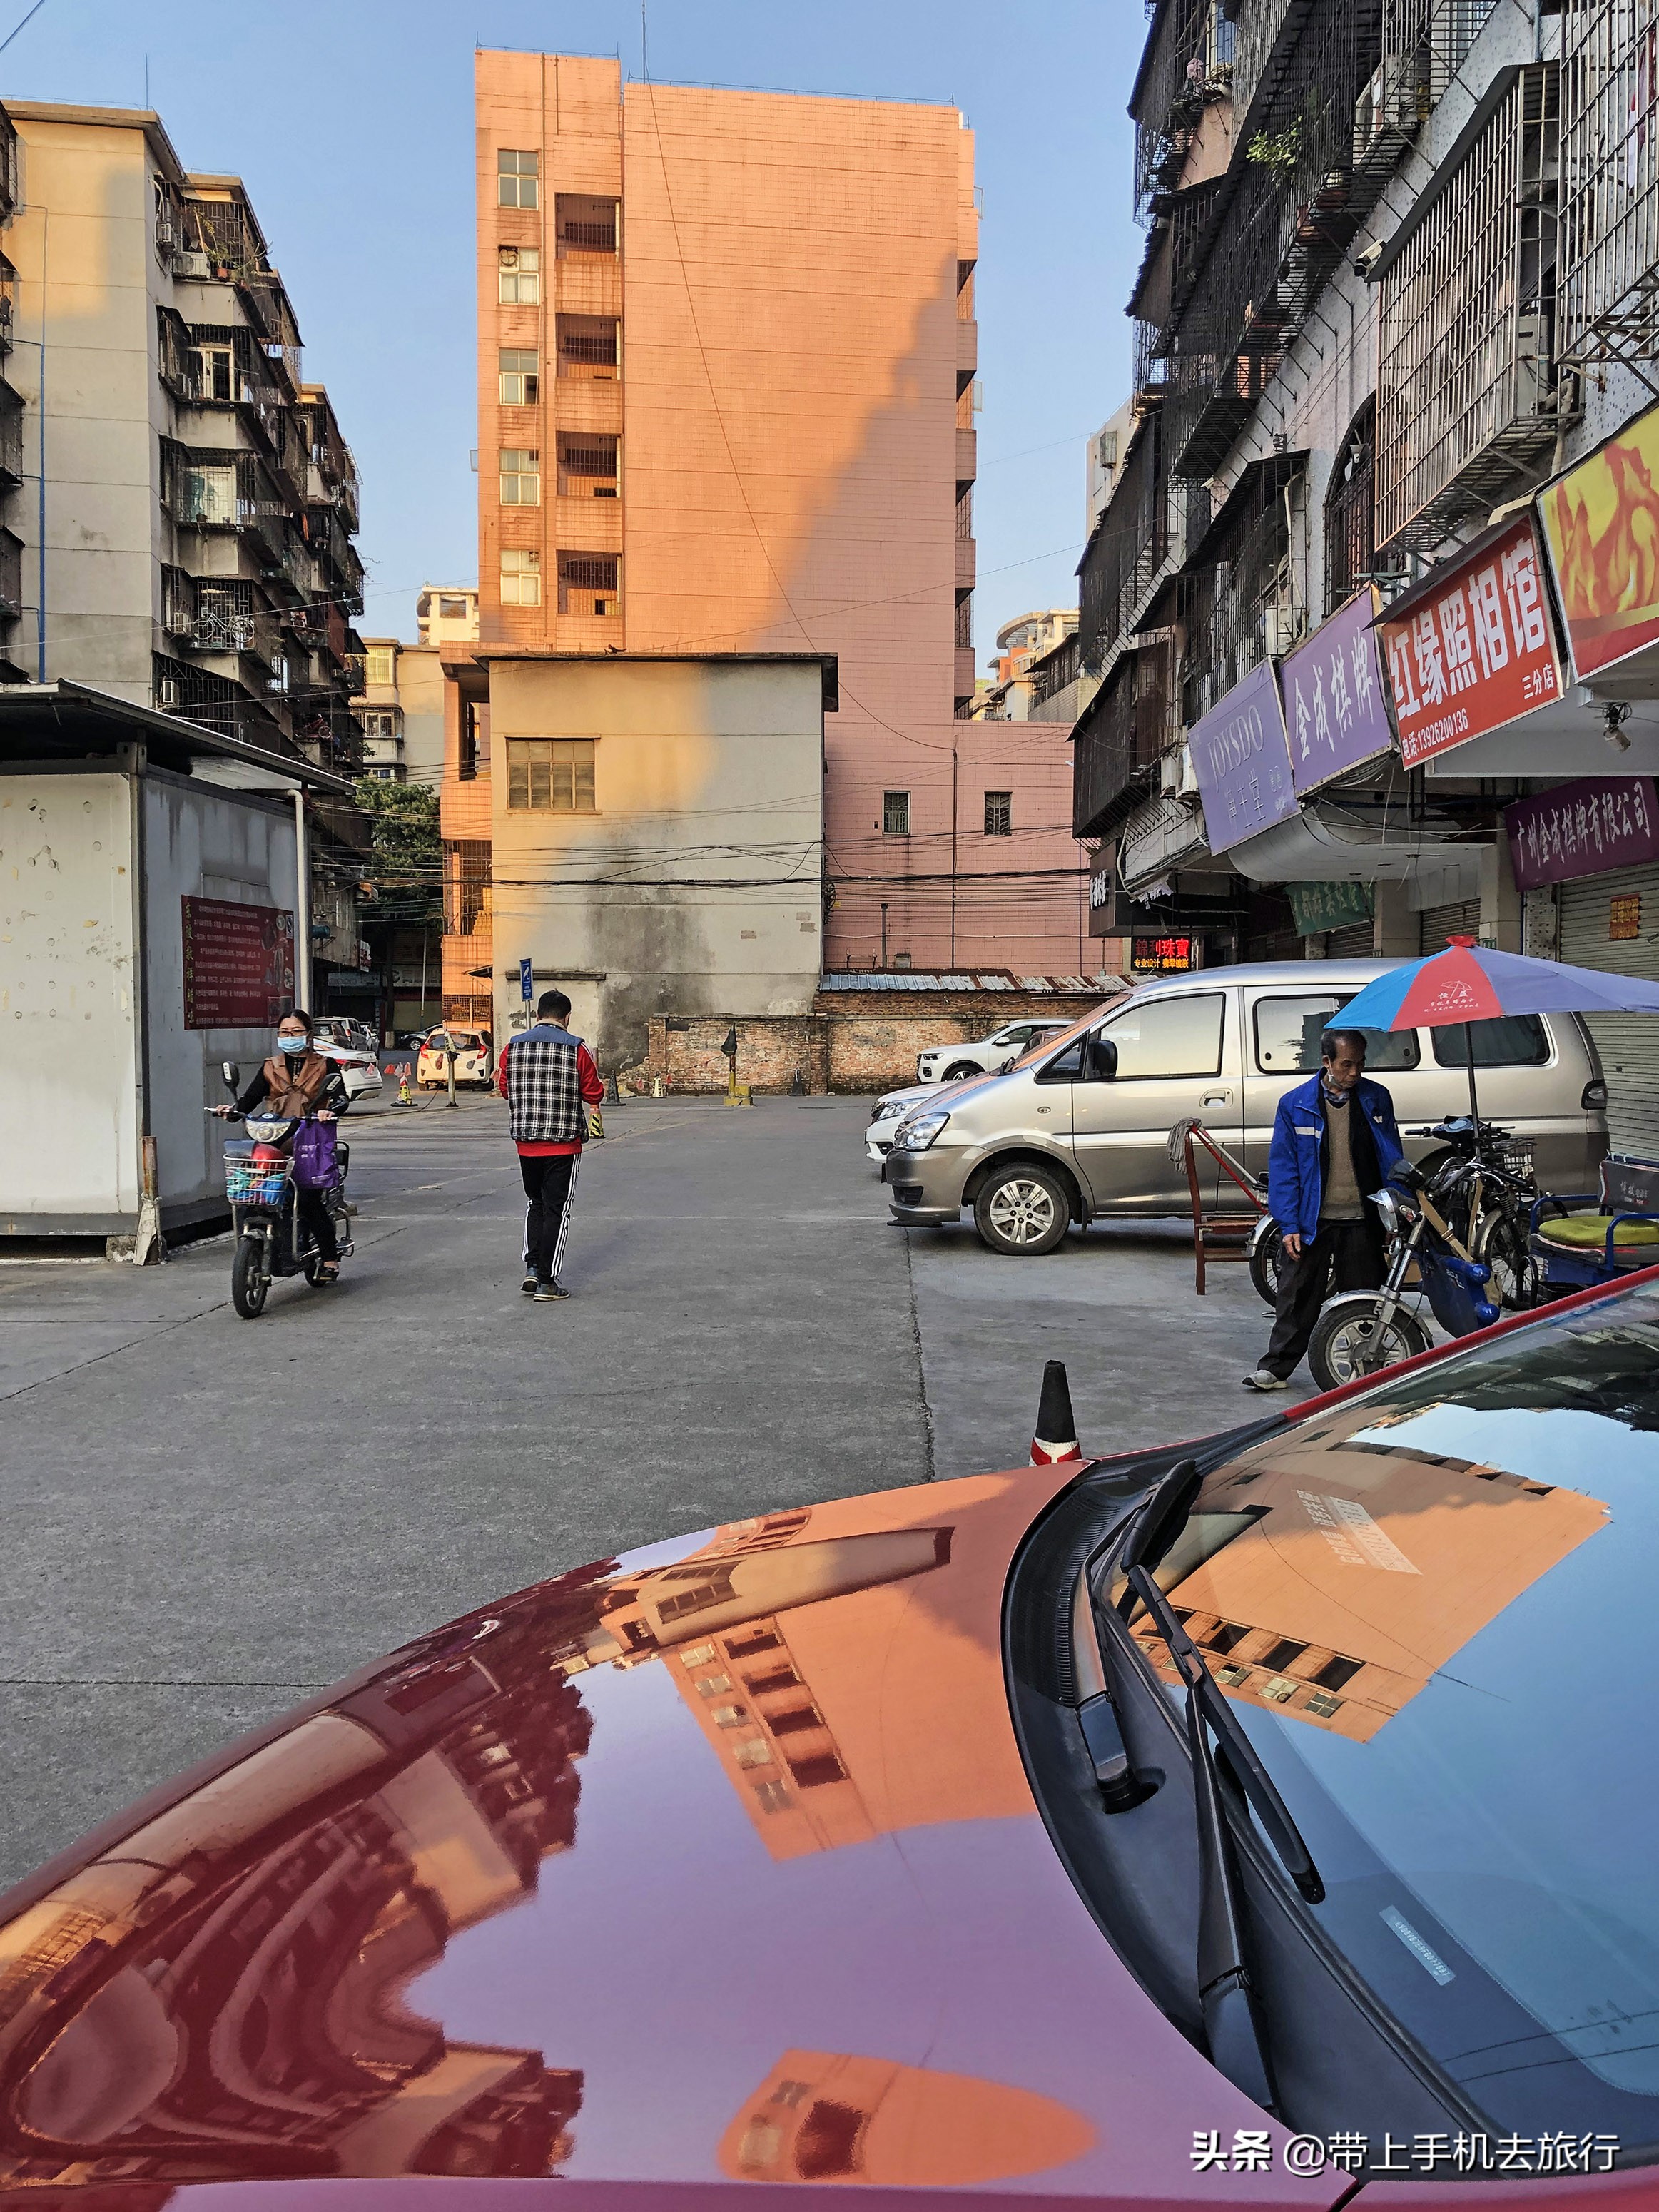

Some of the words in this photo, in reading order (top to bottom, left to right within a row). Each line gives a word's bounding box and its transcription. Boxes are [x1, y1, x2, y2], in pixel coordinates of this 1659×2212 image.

[1388, 537, 1546, 721] 红缘照相馆
[1521, 663, 1556, 700] 三分店
[1207, 704, 1264, 794] JOYSDO
[1401, 707, 1468, 760] 电话:13926200136
[1134, 958, 1161, 968] 专业设计
[1135, 938, 1189, 958] 錦利珠寶
